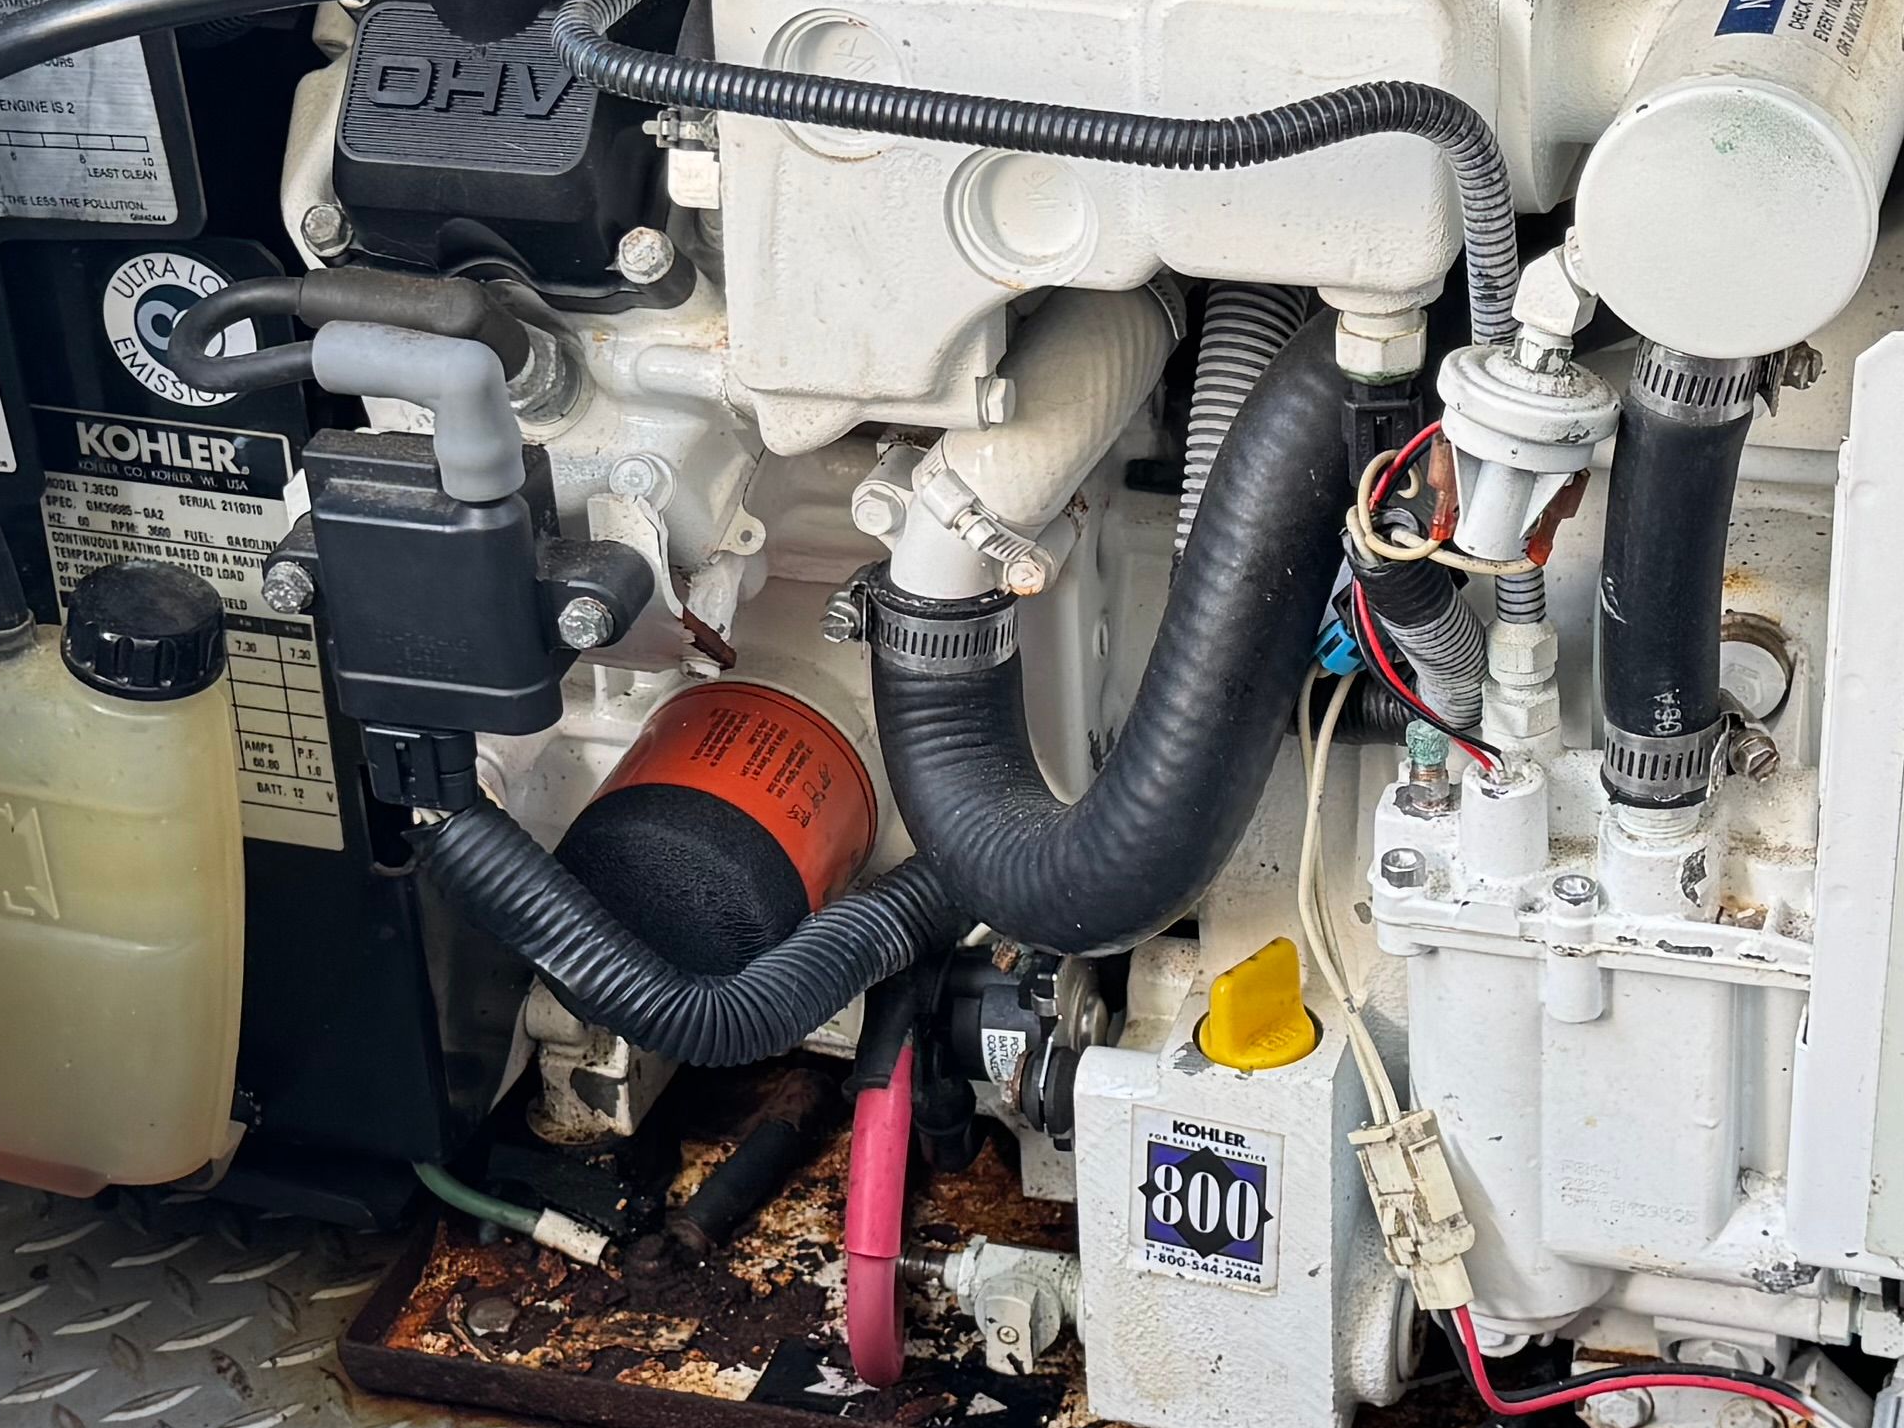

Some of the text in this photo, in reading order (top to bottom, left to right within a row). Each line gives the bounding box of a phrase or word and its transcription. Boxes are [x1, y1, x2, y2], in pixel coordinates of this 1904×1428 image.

[1813, 6, 1836, 43] EVERY
[1837, 39, 1852, 57] OR
[368, 54, 576, 120] OHV
[50, 101, 65, 114] IS
[65, 102, 75, 114] 2
[141, 156, 154, 167] 10
[87, 167, 158, 181] LEAST CLEAN
[112, 256, 180, 299] ULTRA
[76, 421, 241, 475] KOHLER
[226, 479, 248, 491] USA
[179, 494, 217, 510] SERIAL
[184, 530, 214, 543] FUEL:
[52, 531, 228, 564] CONTINUOUS RATING BASED ON A
[218, 567, 244, 581] LOAD
[244, 740, 274, 754] AMPS
[297, 748, 318, 760] P.F.
[256, 782, 304, 799] BATT. 12
[326, 791, 334, 802] V
[1172, 1120, 1247, 1149] KOHLER
[1149, 1133, 1266, 1162] FOR SALES SERVICE
[1152, 1164, 1259, 1241] 800
[1145, 1250, 1262, 1284] 1-800-544-2444
